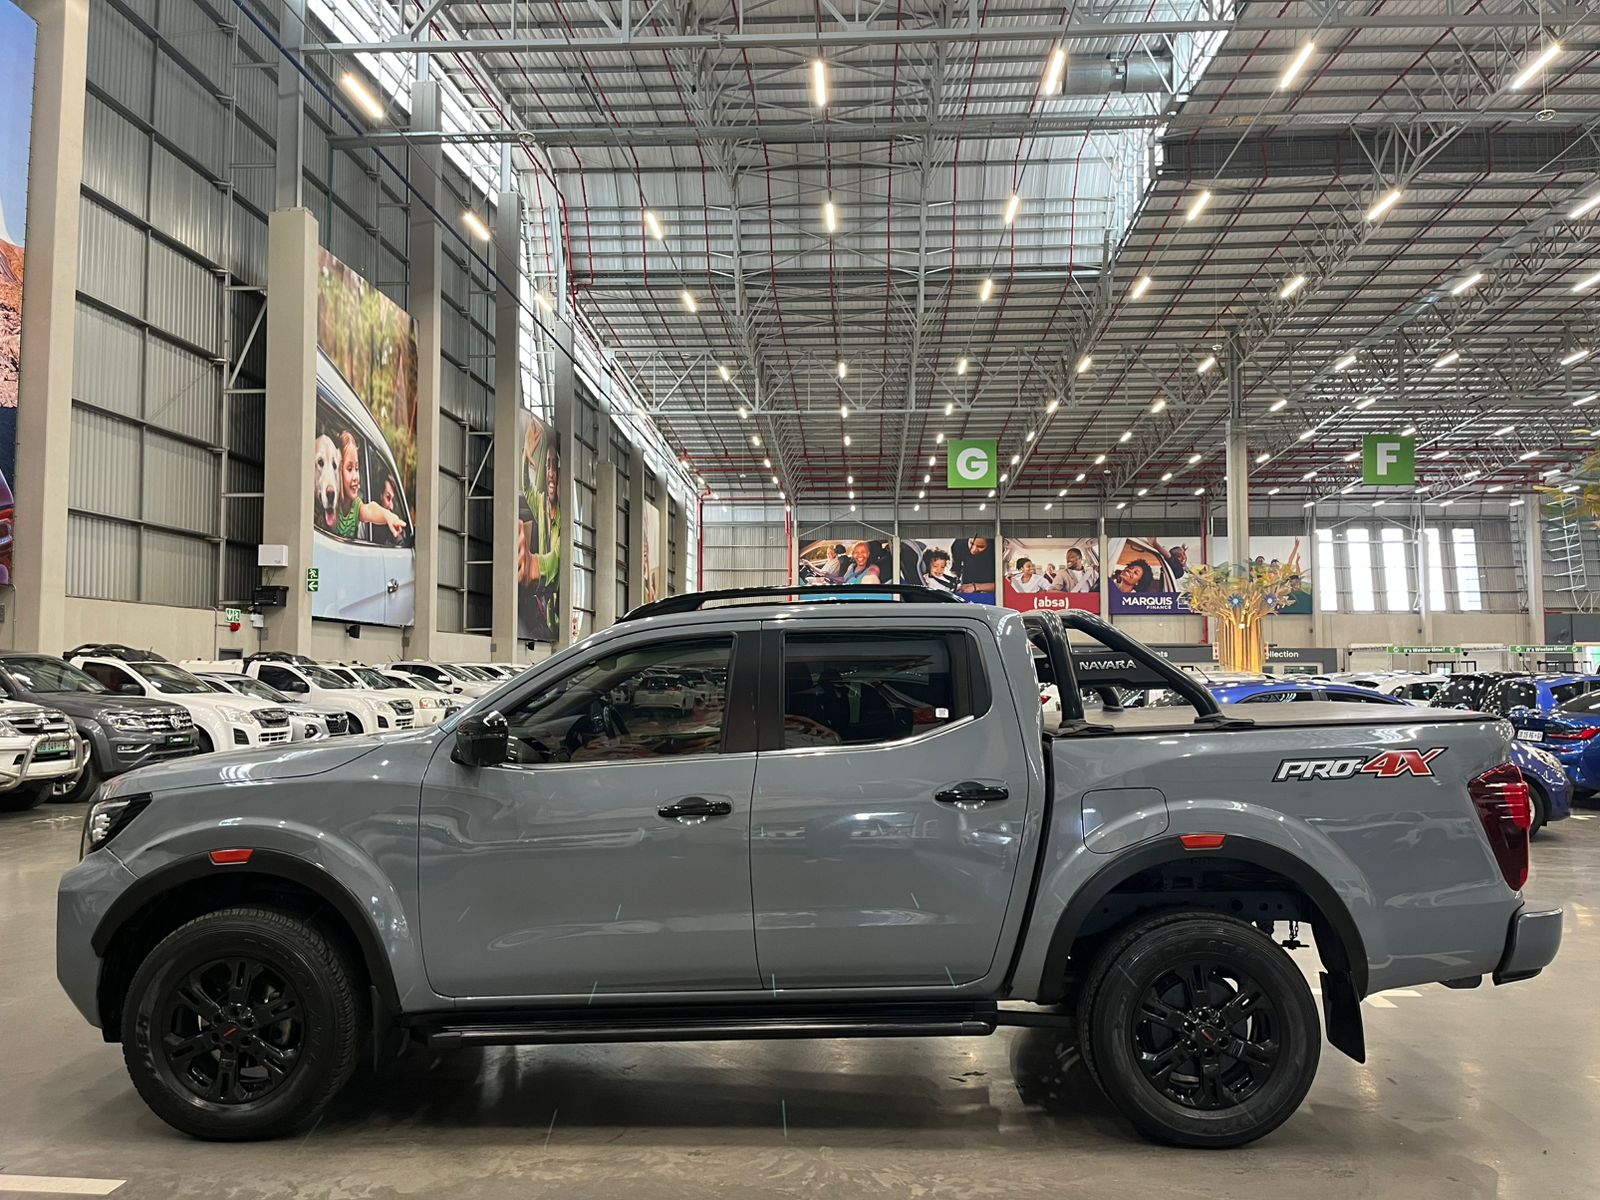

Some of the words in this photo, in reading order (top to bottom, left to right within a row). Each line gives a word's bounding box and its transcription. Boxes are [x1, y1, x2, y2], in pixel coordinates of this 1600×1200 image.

[956, 447, 988, 480] G
[1377, 442, 1400, 475] F
[1033, 596, 1069, 609] (absa)
[1122, 596, 1173, 605] MARQUIS
[1079, 659, 1137, 670] NAVARA
